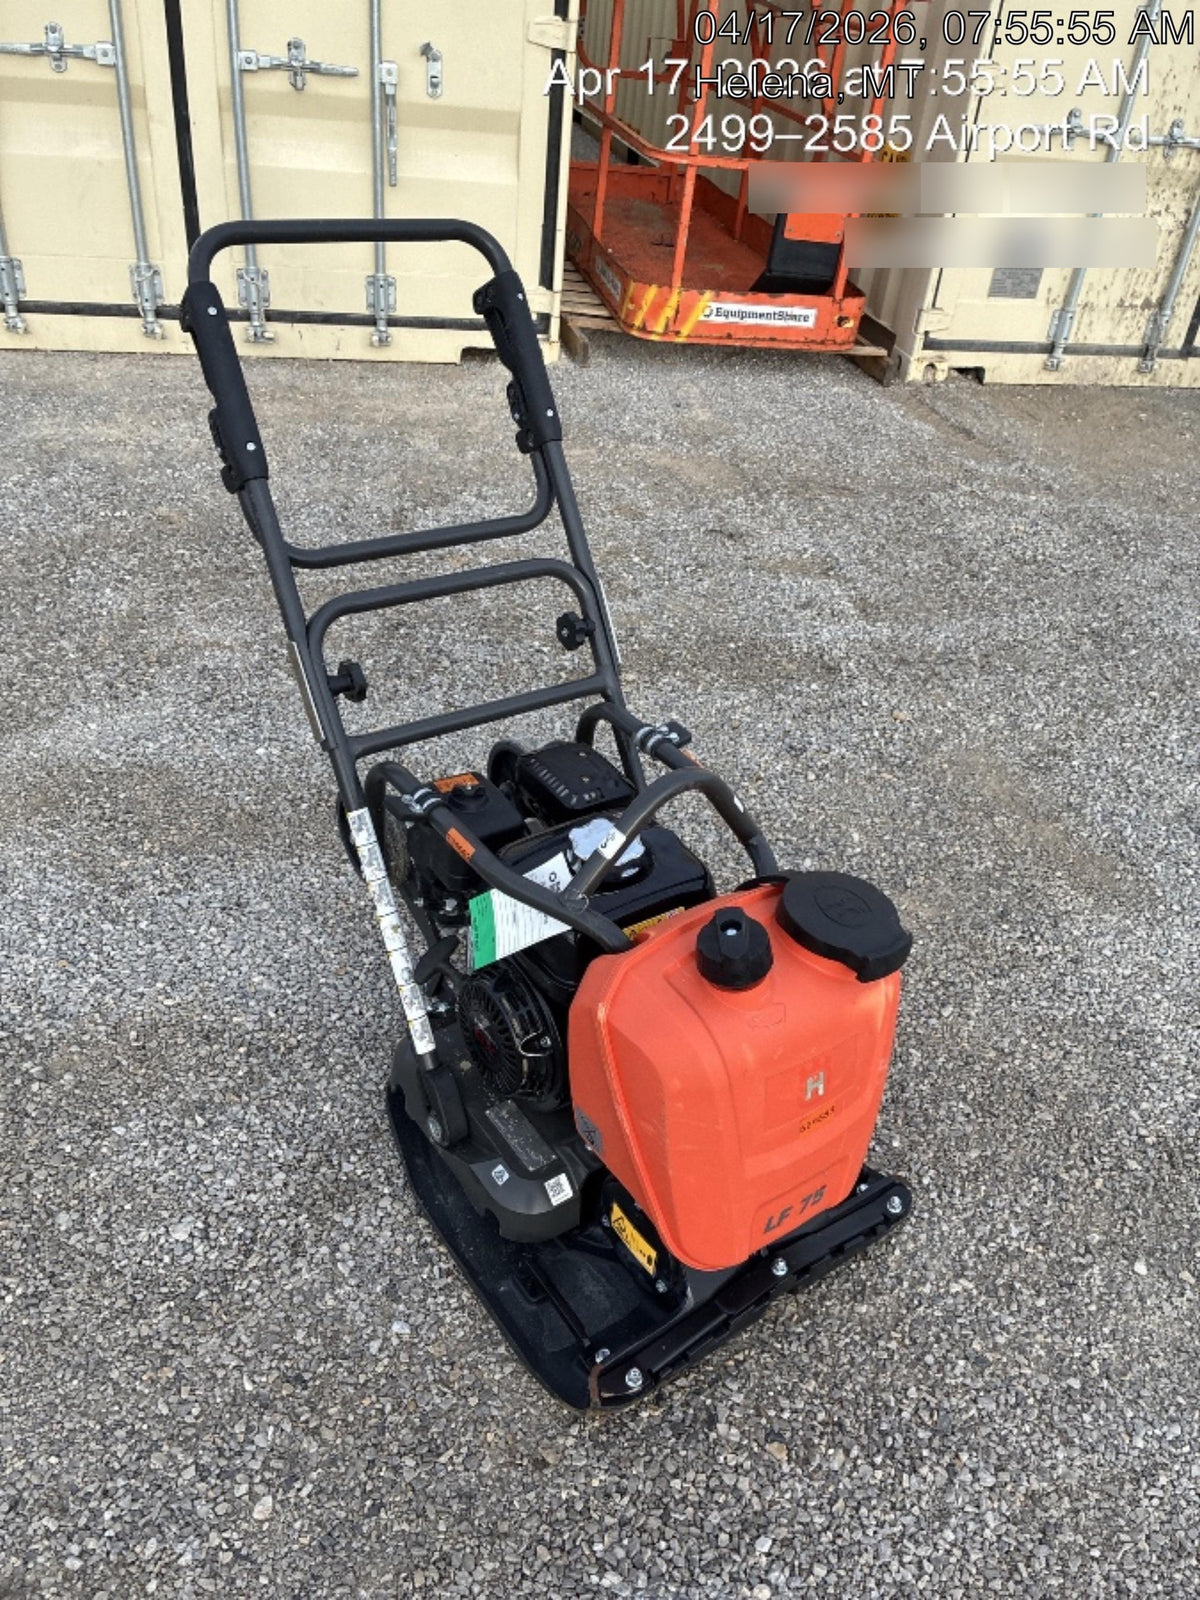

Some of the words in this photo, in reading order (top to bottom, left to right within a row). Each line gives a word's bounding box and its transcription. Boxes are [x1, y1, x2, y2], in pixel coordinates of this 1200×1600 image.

[714, 306, 810, 322] EquipmentShare
[763, 1205, 794, 1235] LF
[799, 1184, 827, 1215] 75
